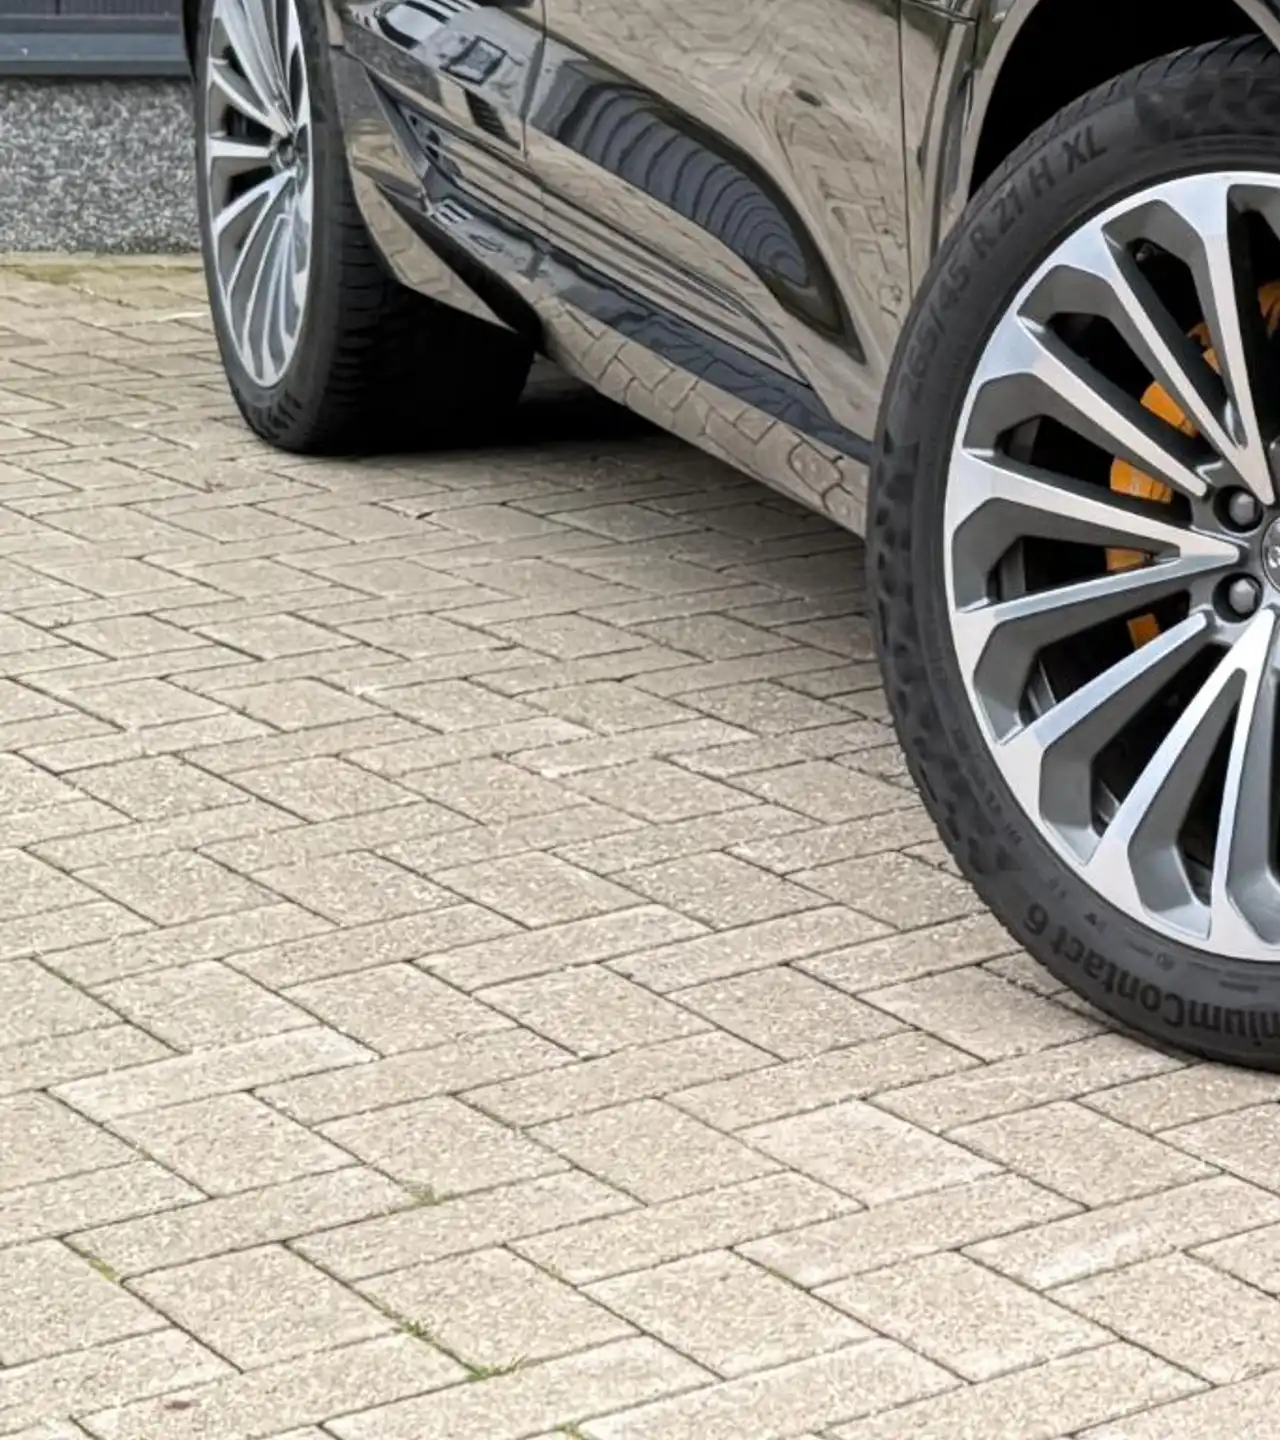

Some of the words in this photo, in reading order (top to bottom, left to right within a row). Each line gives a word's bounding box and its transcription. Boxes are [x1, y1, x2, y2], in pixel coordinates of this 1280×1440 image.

[969, 222, 998, 261] R
[991, 183, 1025, 235] 21
[1029, 157, 1057, 198] H
[1061, 124, 1108, 174] XL
[1022, 901, 1050, 936] 6
